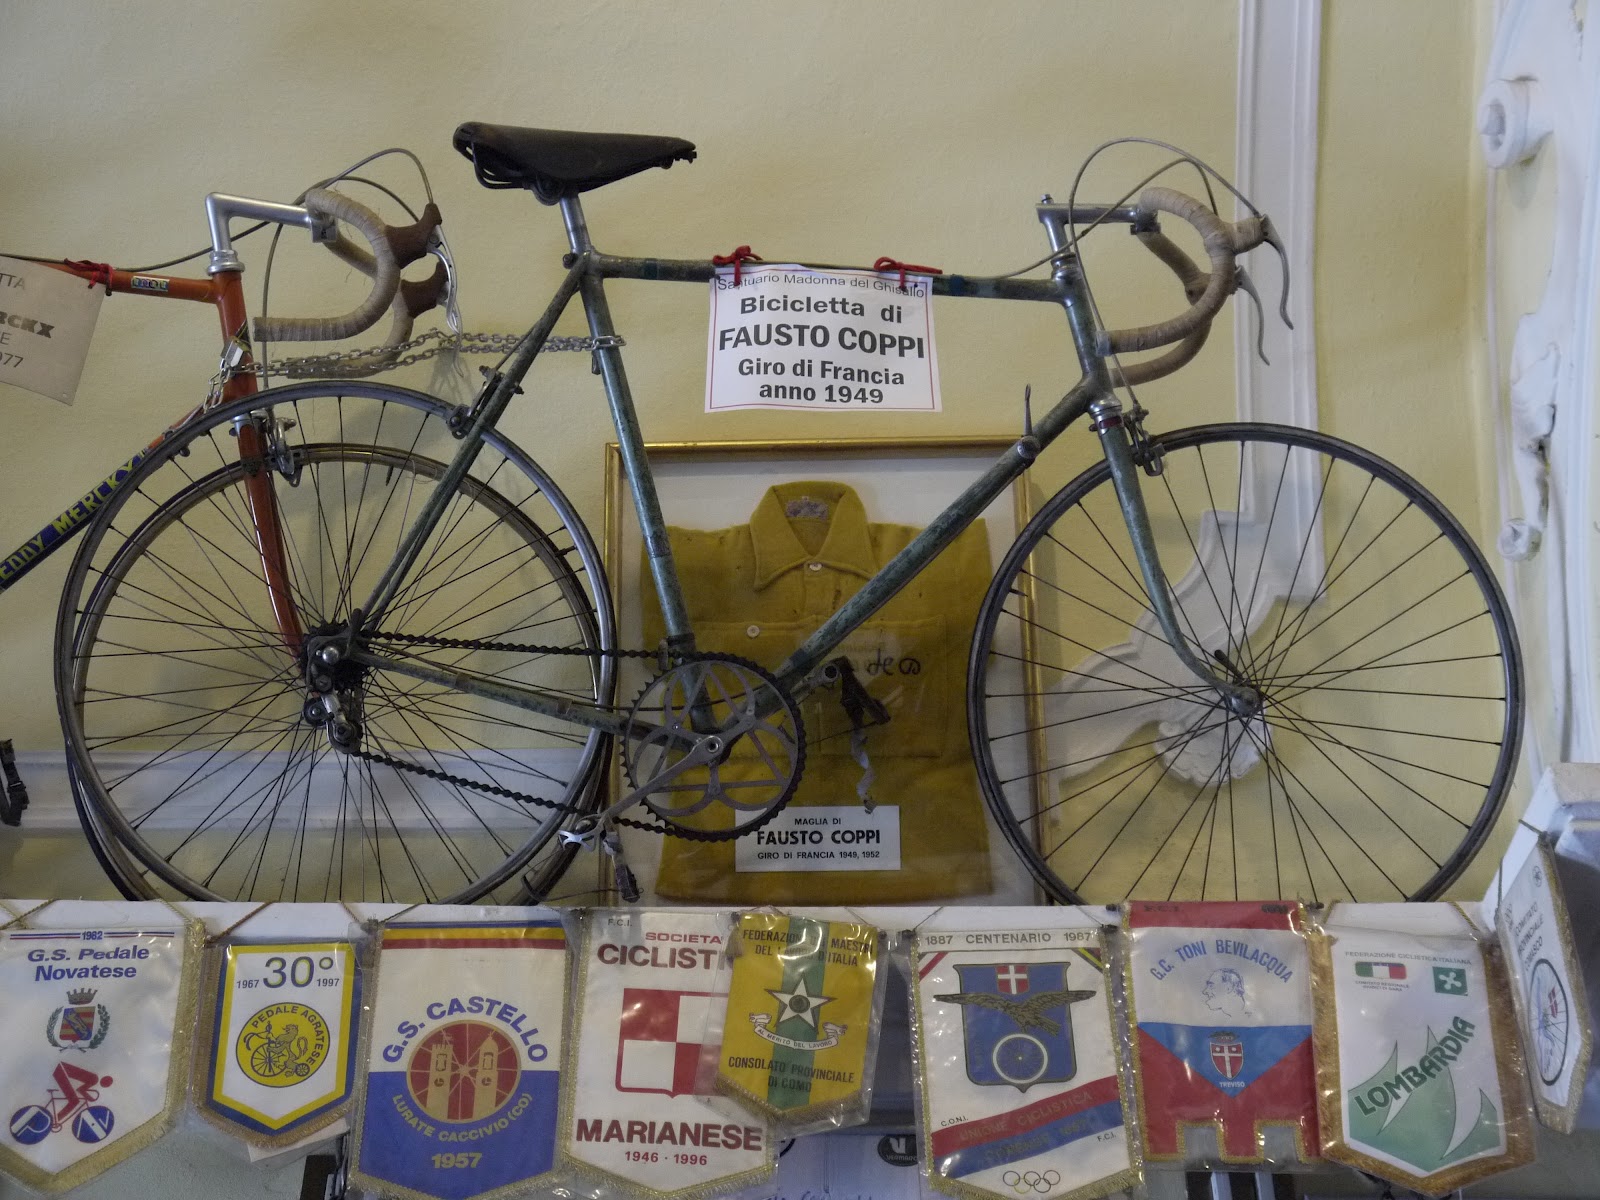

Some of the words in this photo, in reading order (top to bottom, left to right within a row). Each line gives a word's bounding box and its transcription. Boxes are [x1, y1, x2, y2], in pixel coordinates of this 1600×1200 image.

[718, 273, 780, 290] Santuario
[784, 274, 845, 287] Madonna
[851, 278, 869, 288] del
[873, 280, 924, 298] Ghisallo
[741, 295, 865, 317] Bicicletta
[881, 305, 902, 323] di
[719, 323, 829, 350] FAUSTO
[838, 327, 924, 358] COPPI
[738, 358, 785, 376] Giro
[792, 359, 813, 377] di
[820, 361, 904, 385] Francia
[759, 384, 816, 402] anno
[824, 385, 884, 403] 1949
[0, 533, 47, 580] EDDY
[757, 830, 823, 845] FAUSTO
[831, 829, 880, 844] COPPI
[797, 851, 835, 859] FRANCIA
[839, 851, 859, 860] 1949,
[608, 918, 633, 927] F.C.I.
[743, 929, 804, 944] FEDERAZION
[831, 938, 873, 954] MAESTRI
[925, 935, 954, 946] 1887
[965, 933, 1051, 944] CENTENARIO
[1063, 932, 1091, 942] 1987
[28, 949, 70, 962] G.S.
[78, 945, 149, 960] Pedale
[755, 945, 772, 956] DEL
[1345, 951, 1396, 959] FEDERAZIONE
[1439, 957, 1472, 965] ITALIANA
[1150, 958, 1175, 981] G.C.
[1175, 941, 1207, 962] TONI
[1215, 939, 1293, 983] BEVILACQUA
[34, 965, 137, 981] Novatese
[237, 980, 259, 989] 1967
[317, 978, 340, 987] 1997
[251, 1005, 299, 1028] PEDALE
[301, 1010, 325, 1065] AGRATESE
[382, 1021, 425, 1063] G.S.
[426, 996, 548, 1062] CASTELLO
[757, 1029, 765, 1037] AL
[767, 1033, 791, 1045] MERITO
[794, 1041, 805, 1049] DEL
[808, 1040, 833, 1049] LAVORO
[728, 1056, 785, 1073] CONSOLATO
[791, 1065, 855, 1083] PROVINCIALE
[1354, 1016, 1476, 1116] LOMBARDIA
[768, 1075, 777, 1087] DI
[782, 1077, 812, 1092] COMO
[392, 1094, 436, 1137] LURATE
[438, 1118, 509, 1142] CACCIVIO
[508, 1093, 533, 1121] (CO)
[941, 1116, 969, 1127] C.O.N.I.
[960, 1122, 1008, 1141] UNIONE
[1017, 1091, 1092, 1126] CICLISTICA
[576, 1118, 763, 1151] MARIANESE
[1097, 1132, 1116, 1142] F.C.I.
[432, 1153, 482, 1169] 1957
[625, 1151, 658, 1163] 1946
[674, 1154, 707, 1166] 1996
